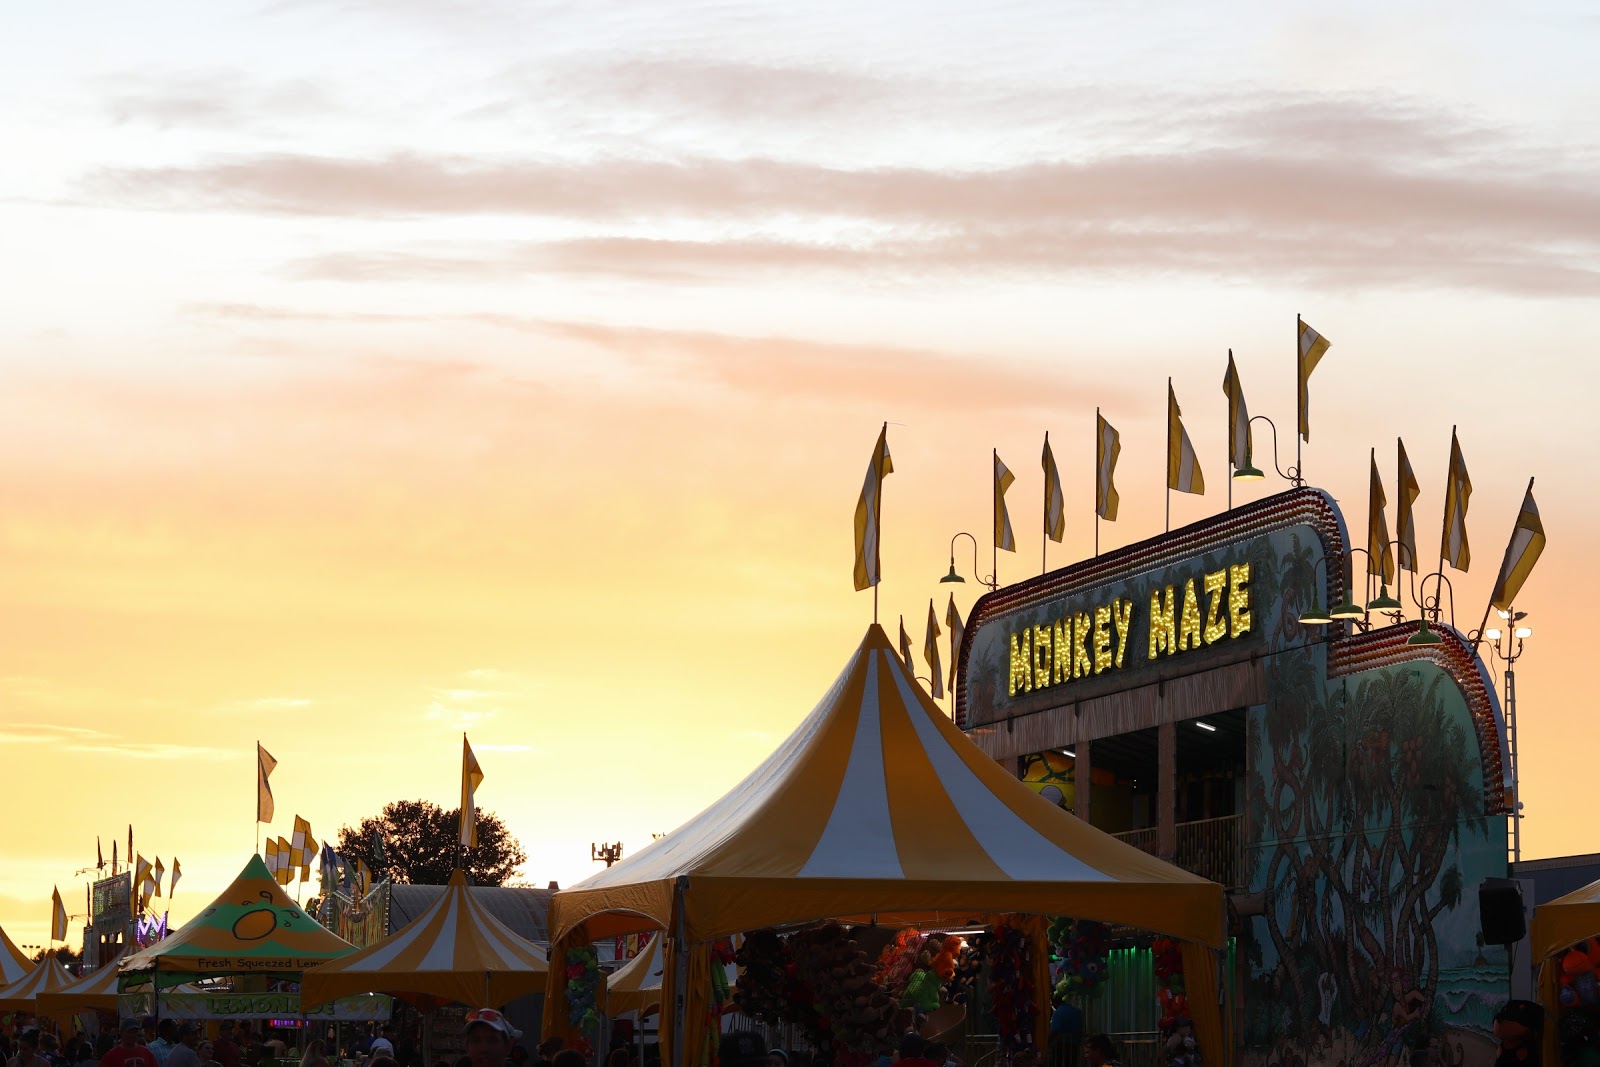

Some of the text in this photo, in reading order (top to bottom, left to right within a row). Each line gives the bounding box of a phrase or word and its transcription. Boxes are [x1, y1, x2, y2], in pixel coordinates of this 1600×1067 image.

[1008, 562, 1252, 697] MONKEY MAZE
[198, 958, 324, 970] Fresh Squeezed Lem
